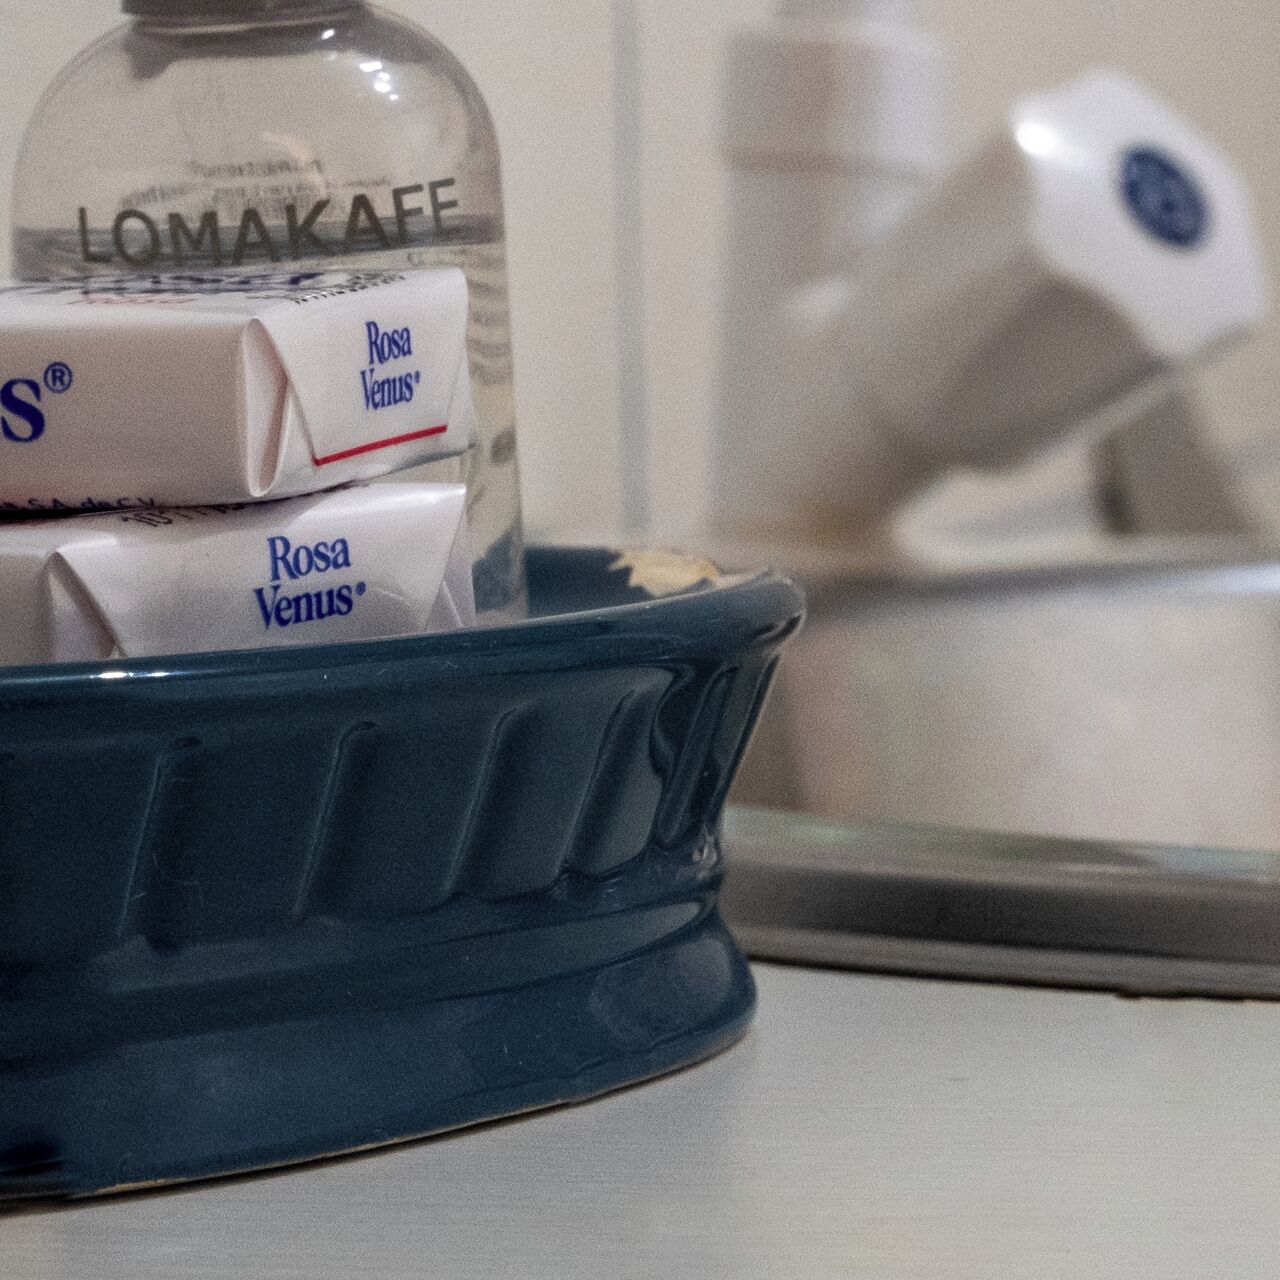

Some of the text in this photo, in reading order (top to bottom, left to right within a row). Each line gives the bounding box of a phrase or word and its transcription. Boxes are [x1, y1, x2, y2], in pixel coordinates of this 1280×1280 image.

[78, 177, 459, 267] LOMAKAFE
[365, 321, 412, 365] Rosa
[267, 536, 351, 581] Rosa
